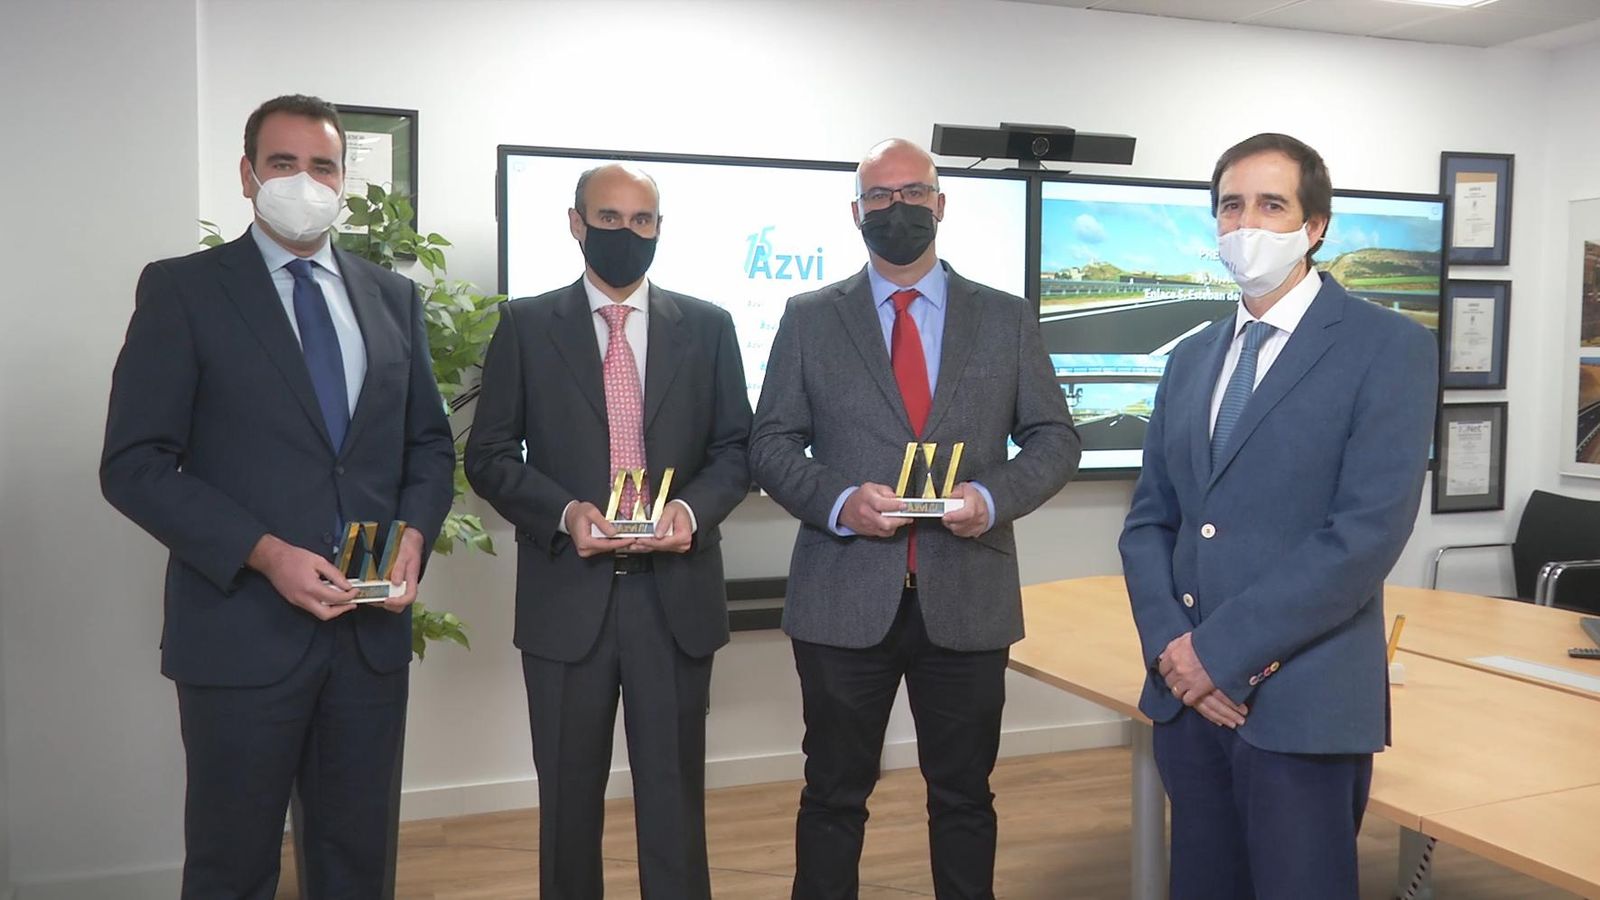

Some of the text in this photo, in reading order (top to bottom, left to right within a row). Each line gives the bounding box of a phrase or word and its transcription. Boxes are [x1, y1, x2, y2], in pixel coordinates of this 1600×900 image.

[1200, 248, 1220, 260] PRE
[748, 244, 824, 281] Azvi
[1144, 287, 1176, 299] Enlace
[1188, 287, 1226, 301] Esteban
[1227, 290, 1240, 301] de
